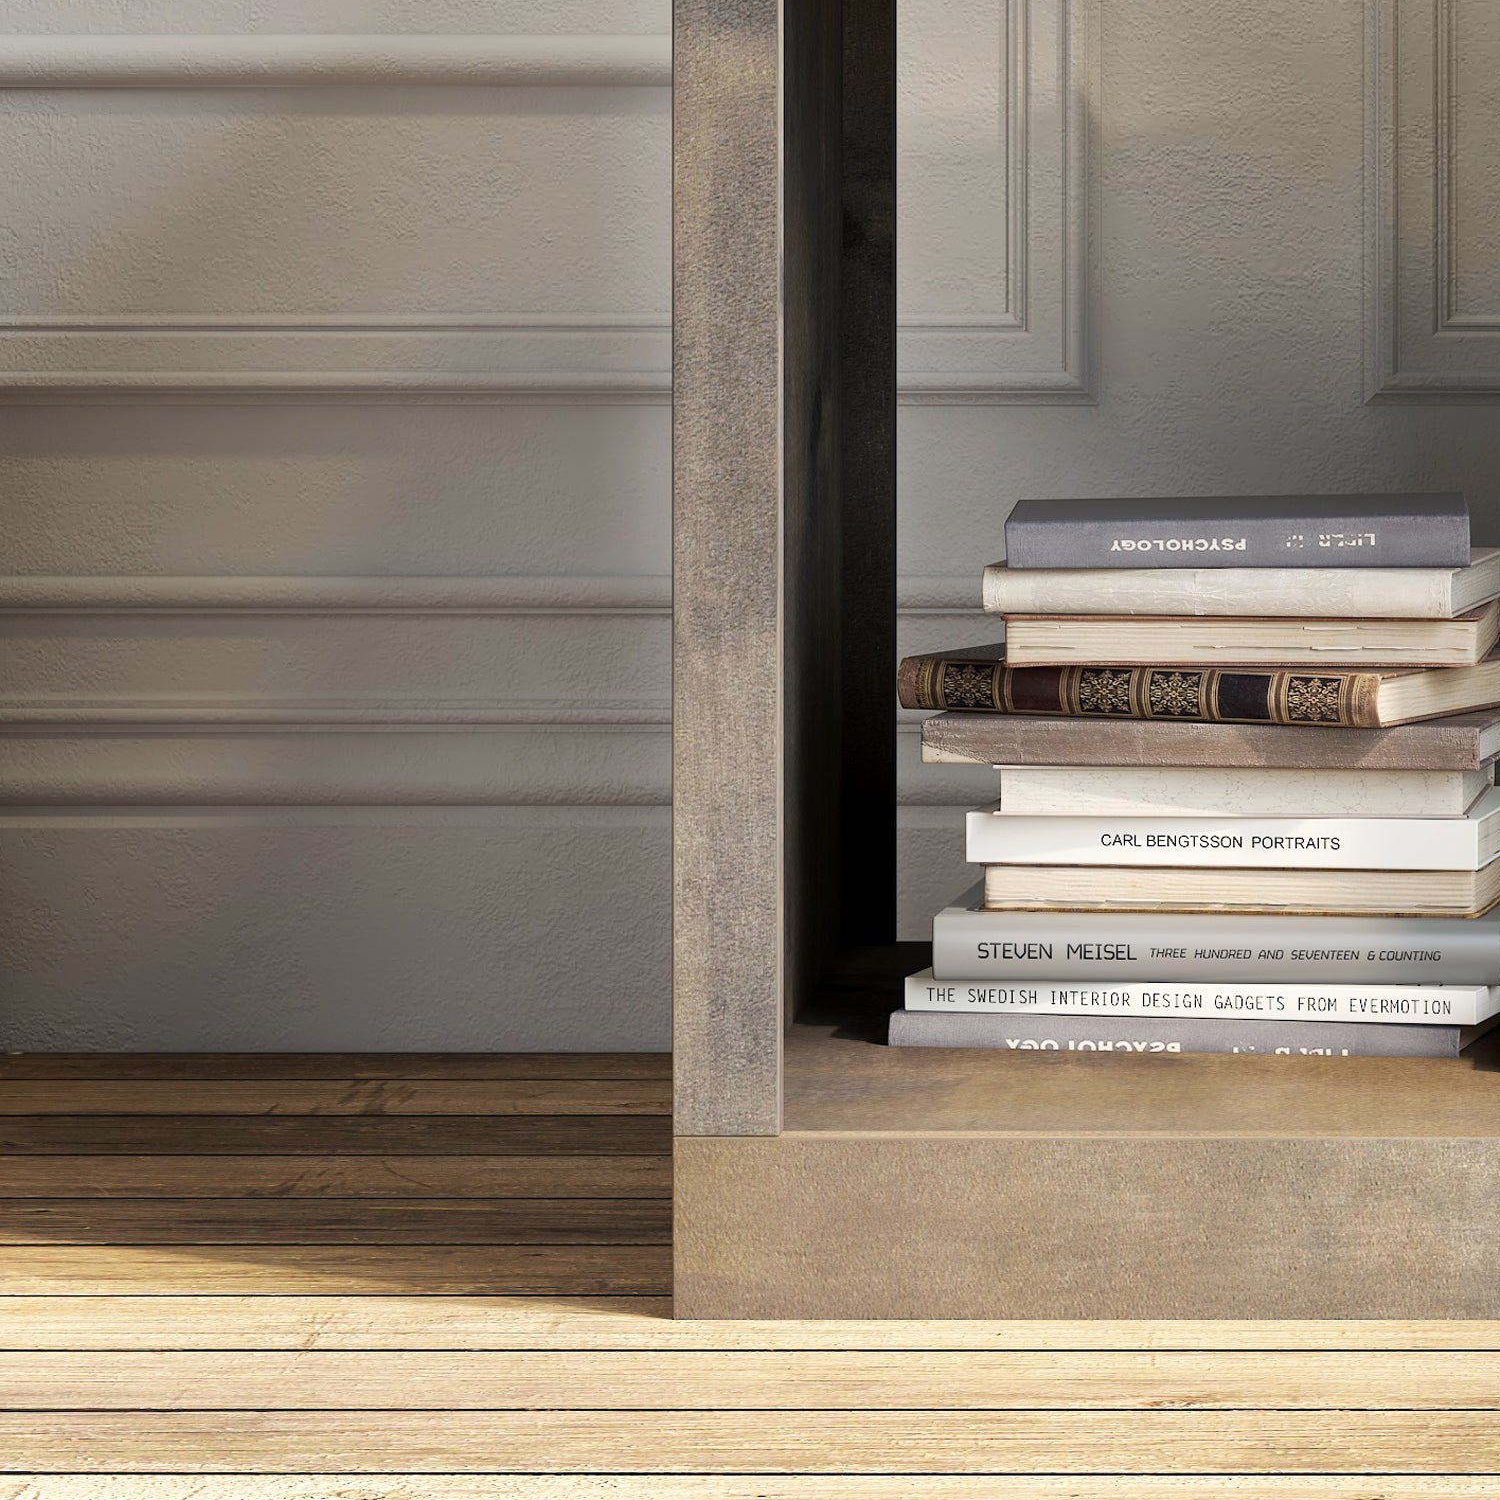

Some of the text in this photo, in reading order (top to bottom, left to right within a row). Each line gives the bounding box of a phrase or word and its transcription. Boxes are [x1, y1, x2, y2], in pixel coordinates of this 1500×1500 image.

[1110, 538, 1247, 552] PSYCHOLOGY
[1100, 833, 1341, 851] CARL BENGTSSON PORTRAITS
[977, 942, 1053, 960] STEVEN
[1066, 943, 1138, 961] MEISEL
[1150, 947, 1187, 959] THREE
[1194, 948, 1252, 960] HUNDRED
[1257, 949, 1284, 960] AND
[1290, 949, 1360, 961] SEVENTEEN
[1378, 950, 1442, 962] COUNTING
[926, 987, 1452, 1015] THE SWEDISH INTERIOR DESIGN GADGETS FROM EVERMOTION
